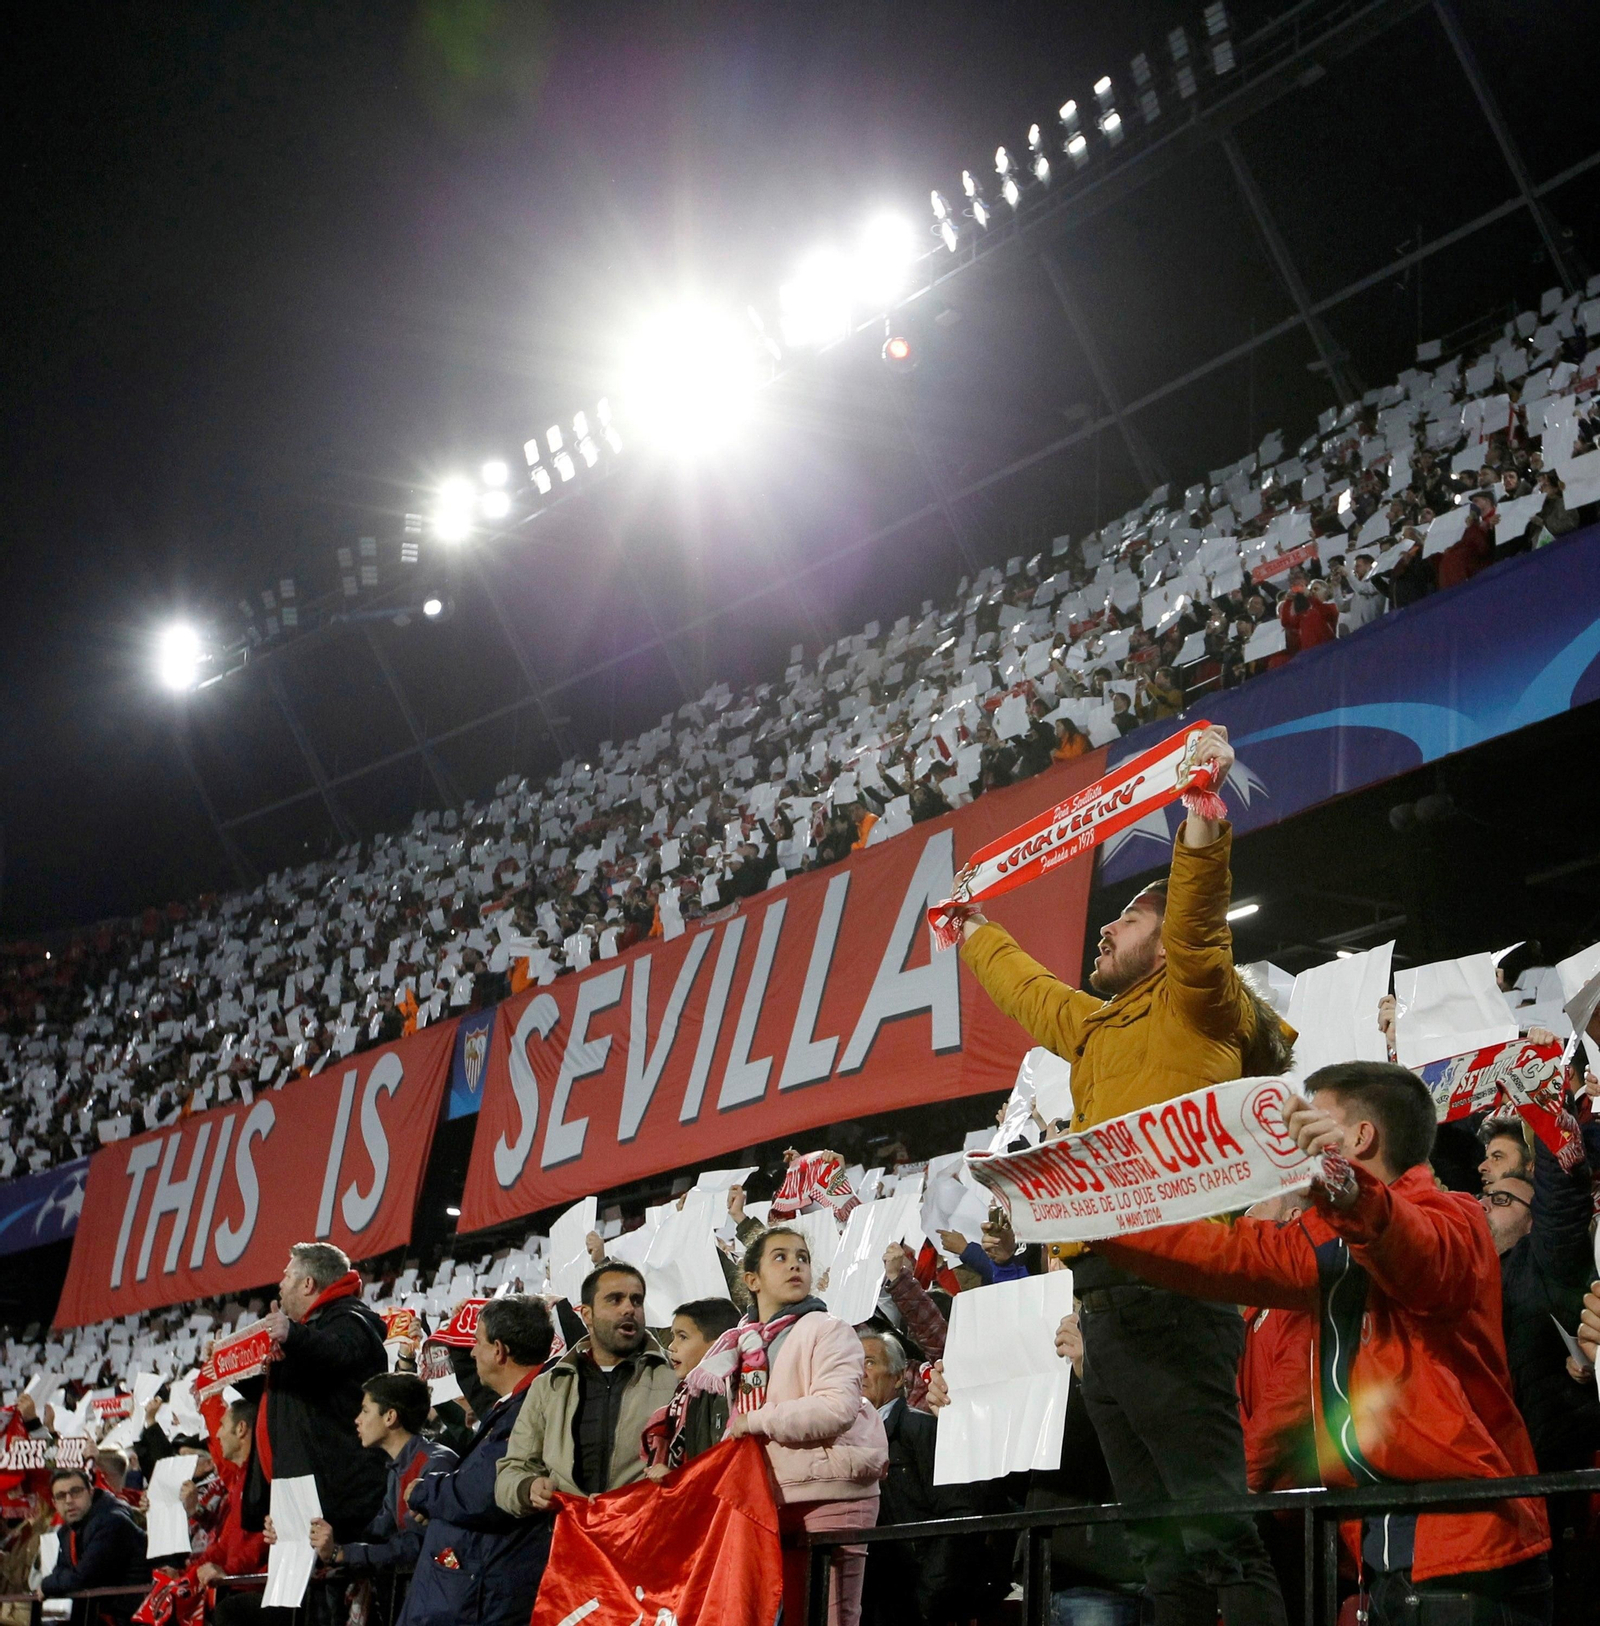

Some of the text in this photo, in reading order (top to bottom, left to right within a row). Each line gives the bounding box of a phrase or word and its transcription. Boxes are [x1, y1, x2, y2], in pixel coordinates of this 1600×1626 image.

[1078, 828, 1096, 851] 1978
[110, 827, 962, 1290] THIS IS SEVILLA
[984, 1120, 1143, 1200] VAMOS A POR
[1138, 1092, 1244, 1173] COPA
[1030, 1161, 1252, 1222] EUROPA SABE DE LO QUE SOMOS CAPACES
[1102, 1156, 1161, 1188] NUESTRA
[1144, 1206, 1163, 1224] 2014
